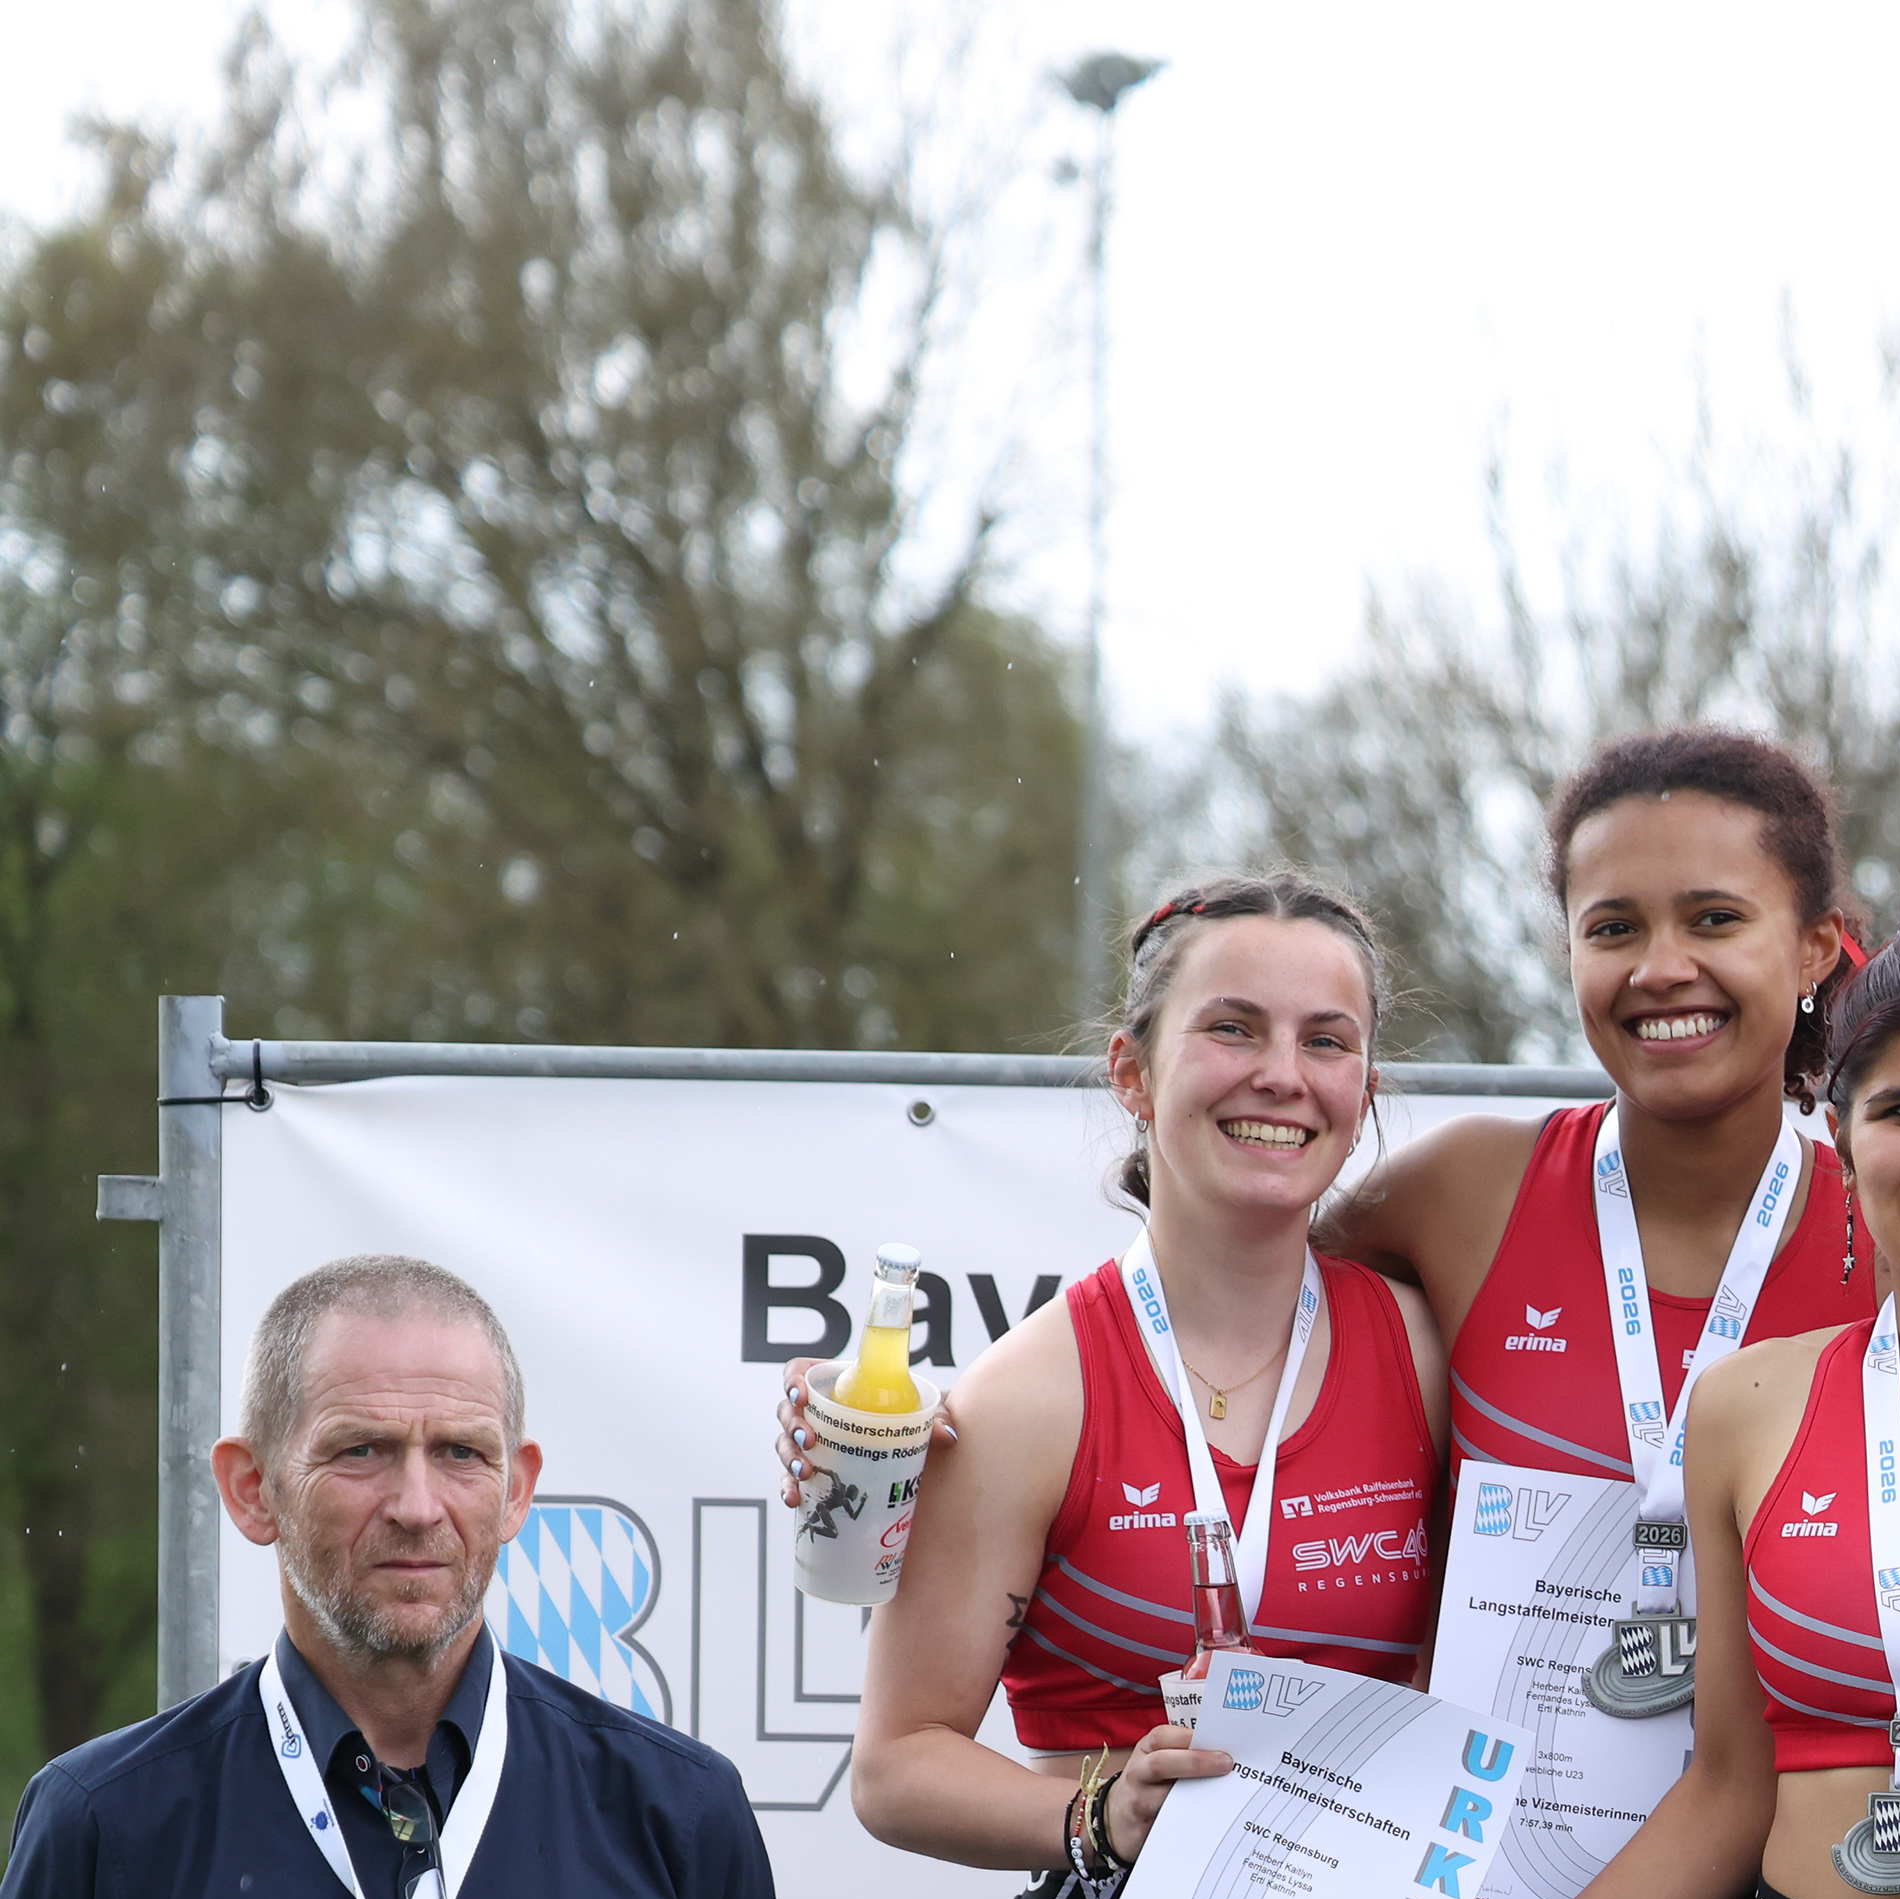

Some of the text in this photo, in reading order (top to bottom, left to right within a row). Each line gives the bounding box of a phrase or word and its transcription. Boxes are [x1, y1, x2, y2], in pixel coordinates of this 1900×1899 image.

[1757, 1161, 1790, 1227] 2026
[1132, 1267, 1170, 1335] 2026
[1618, 1266, 1642, 1336] 2026
[1504, 1332, 1568, 1354] erima
[1879, 1440, 1897, 1504] 2026
[1314, 1486, 1362, 1503] Volksbank
[1318, 1491, 1415, 1513] Regensburg-Schwandorf
[1108, 1508, 1176, 1531] erima
[1473, 1482, 1571, 1541] BLV
[1637, 1526, 1682, 1544] 2026
[1780, 1519, 1839, 1539] erima
[1298, 1569, 1427, 1592] REGENSBU
[1535, 1579, 1622, 1604] Bayerische
[1469, 1596, 1615, 1629] Langstaffelmeister
[1517, 1655, 1544, 1669] SWC
[1222, 1667, 1325, 1718] BLV
[1281, 1751, 1362, 1793] Bayerische
[1232, 1761, 1410, 1841] ngstaffelmeisterschaften
[1532, 1797, 1648, 1823] Vizemeisterinnen
[1243, 1821, 1339, 1869] SWC Regensburg
